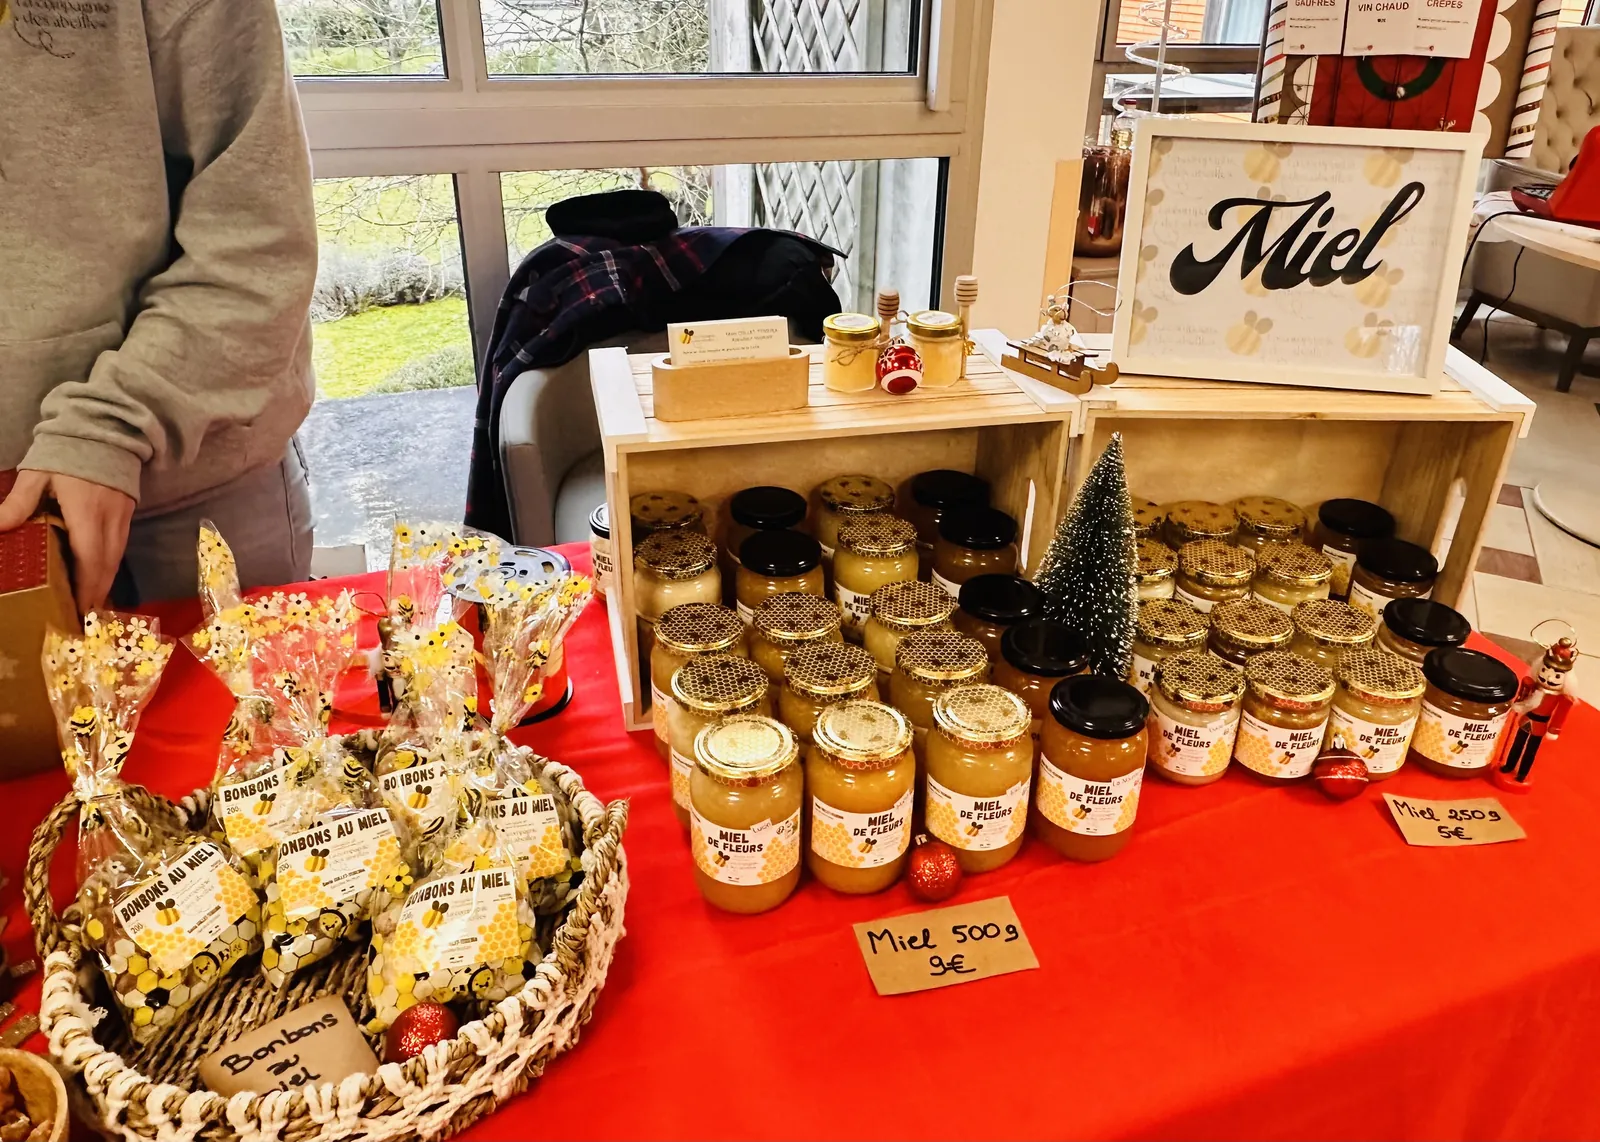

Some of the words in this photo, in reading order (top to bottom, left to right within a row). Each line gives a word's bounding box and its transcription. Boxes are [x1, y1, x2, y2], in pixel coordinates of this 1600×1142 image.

[1357, 3, 1373, 12] VIN
[1375, 2, 1410, 11] CHAUD
[1169, 181, 1426, 296] Miel
[1140, 670, 1150, 680] DE
[1174, 725, 1200, 739] MIEL
[1374, 727, 1399, 738] MIEL
[1462, 722, 1490, 733] MIEL
[1163, 730, 1174, 741] DE
[1175, 736, 1211, 748] FLEURS
[1289, 732, 1313, 742] MIEL
[1359, 734, 1372, 744] DE
[1375, 735, 1406, 745] FLEURS
[1448, 729, 1461, 738] DE
[1464, 732, 1497, 741] FLEURS
[1275, 741, 1288, 749] DE
[1291, 738, 1320, 750] FLEURS
[223, 773, 279, 803] BONBONS
[1083, 784, 1113, 796] MIEL
[1069, 791, 1083, 802] DE
[1086, 795, 1123, 805] FLEURS
[511, 801, 527, 817] AU
[532, 798, 554, 814] MIEL
[973, 800, 1002, 812] MIEL
[1392, 799, 1440, 822] Miel
[867, 812, 895, 827] MIEL
[960, 810, 973, 819] DE
[976, 807, 1012, 820] FLEURS
[337, 820, 354, 839] AU
[357, 811, 387, 831] MIEL
[853, 828, 867, 836] DE
[870, 817, 904, 836] FLEURS
[719, 830, 749, 843] MIEL
[707, 836, 720, 848] DE
[722, 842, 764, 853] FLEURS
[120, 880, 169, 923] BONBONS
[167, 867, 187, 886] AU
[183, 848, 214, 871] MIEL
[405, 881, 455, 908] BONBONS
[459, 876, 475, 894] AU
[481, 871, 510, 890] MIEL
[867, 928, 937, 954] Miel
[220, 1013, 338, 1076] Bonbons
